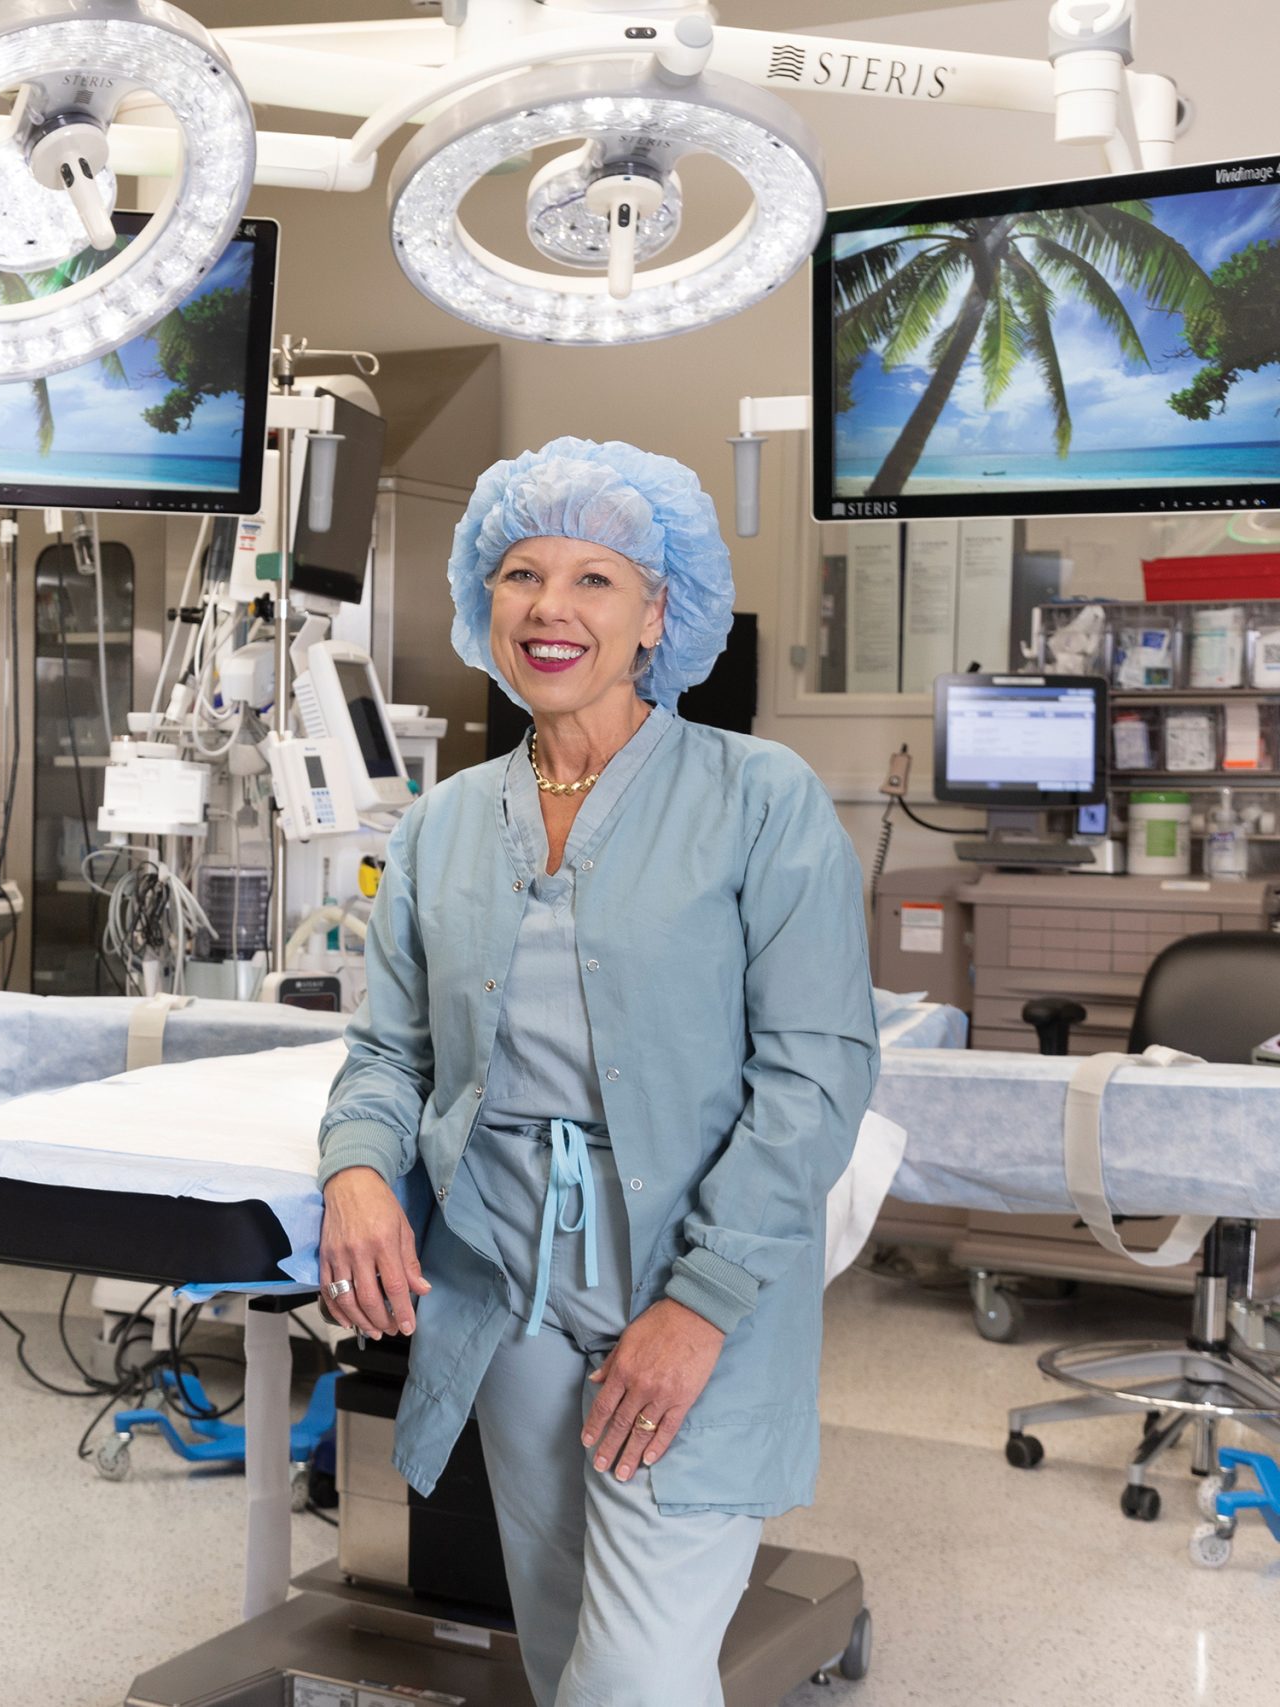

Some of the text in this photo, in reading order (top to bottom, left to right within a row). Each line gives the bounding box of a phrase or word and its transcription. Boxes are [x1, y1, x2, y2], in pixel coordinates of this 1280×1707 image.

[62, 74, 114, 89] STERIS
[813, 51, 949, 99] STERIS
[847, 501, 898, 516] STERIS
